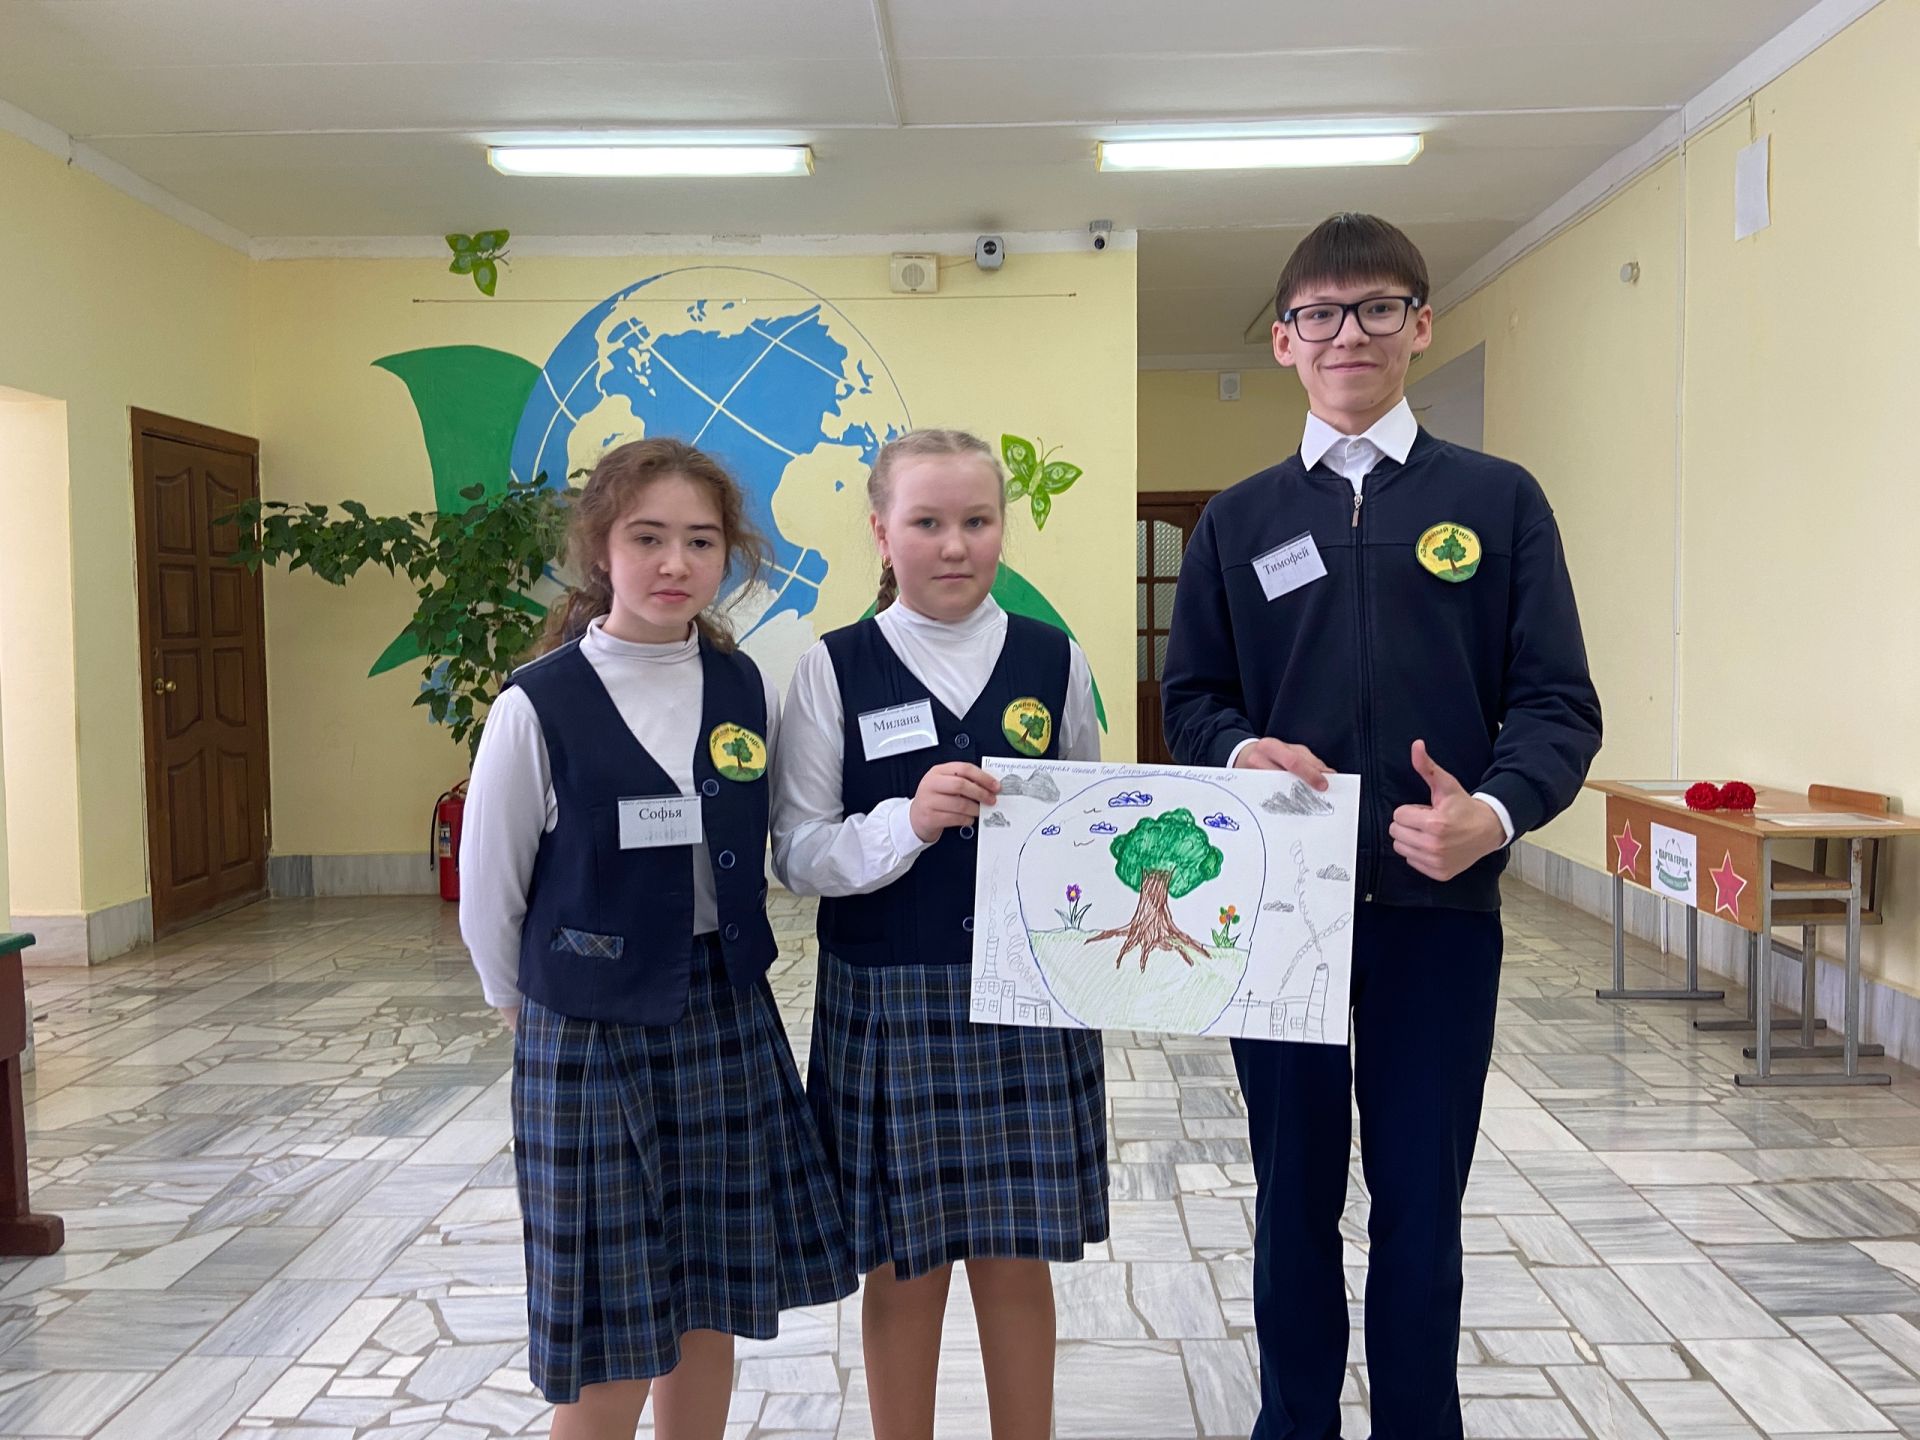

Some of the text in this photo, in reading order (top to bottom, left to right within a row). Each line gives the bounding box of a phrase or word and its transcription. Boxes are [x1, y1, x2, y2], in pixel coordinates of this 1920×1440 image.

[1262, 546, 1310, 575] Тимофей
[873, 715, 920, 733] Милана
[639, 806, 682, 822] Софья
